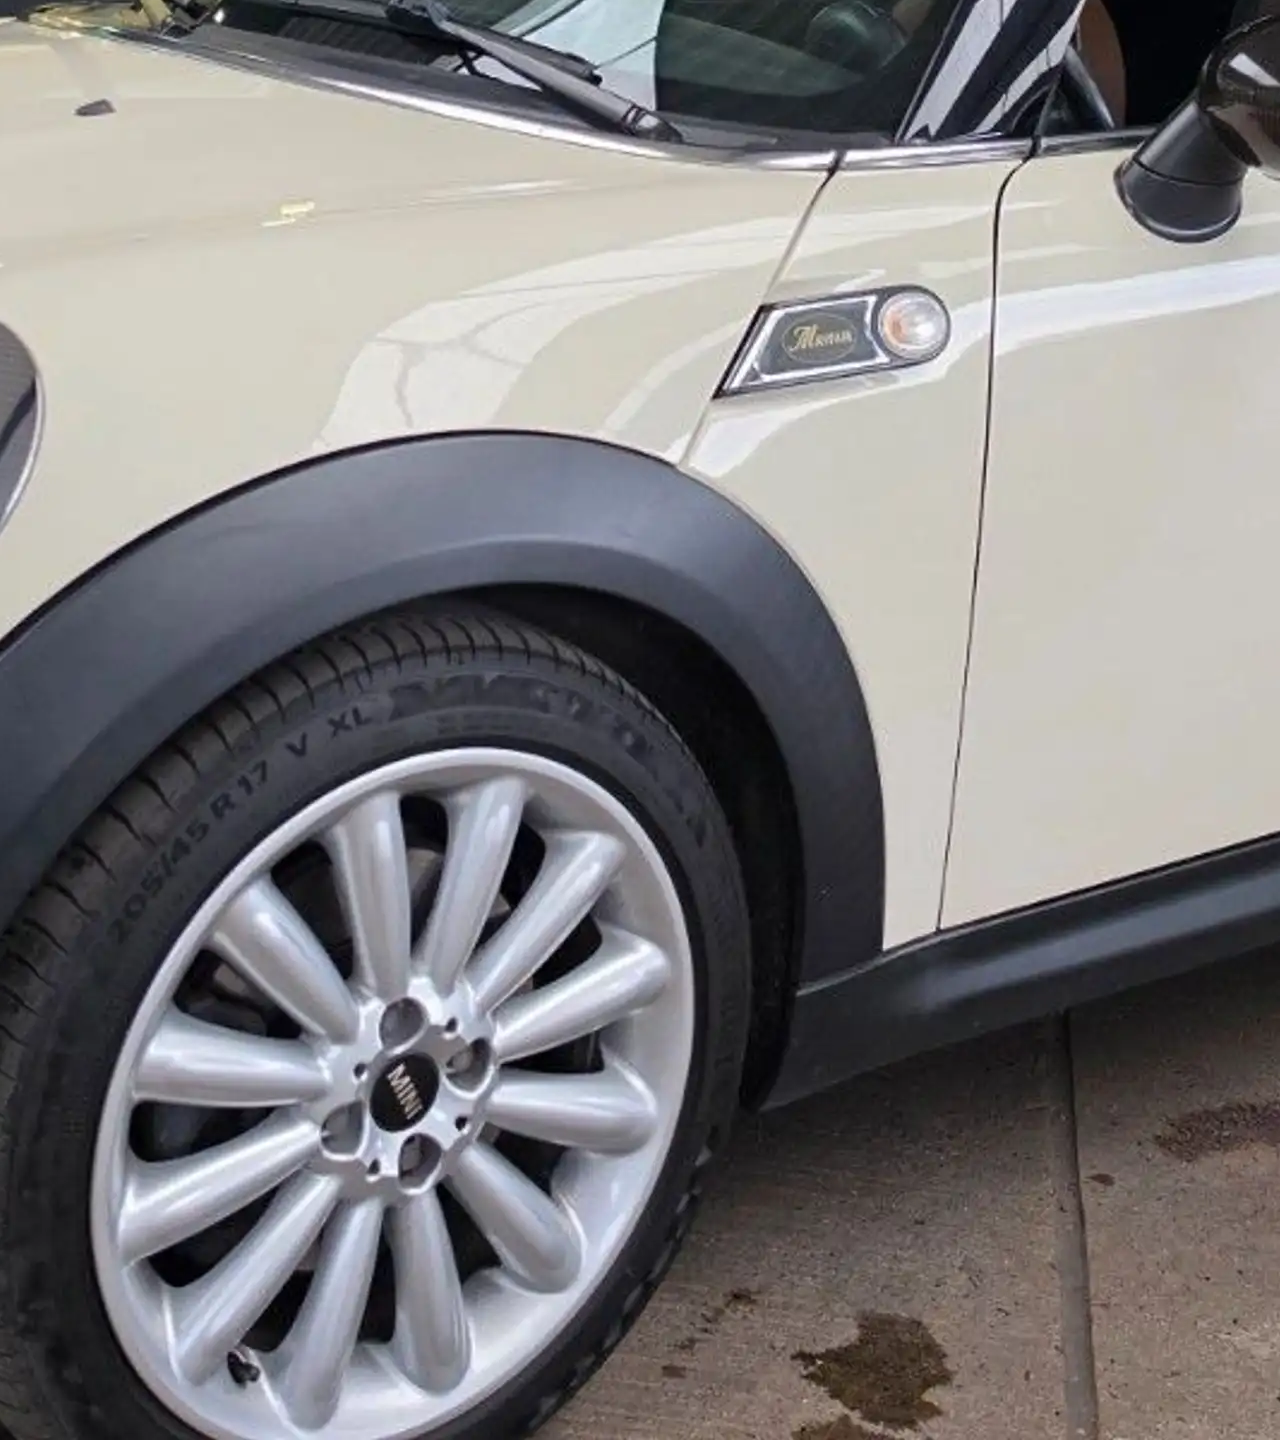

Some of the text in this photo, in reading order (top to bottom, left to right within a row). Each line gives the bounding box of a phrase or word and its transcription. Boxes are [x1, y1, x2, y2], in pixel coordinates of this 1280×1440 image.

[284, 731, 308, 758] V
[326, 705, 374, 738] XL
[387, 1062, 424, 1120] MINI
